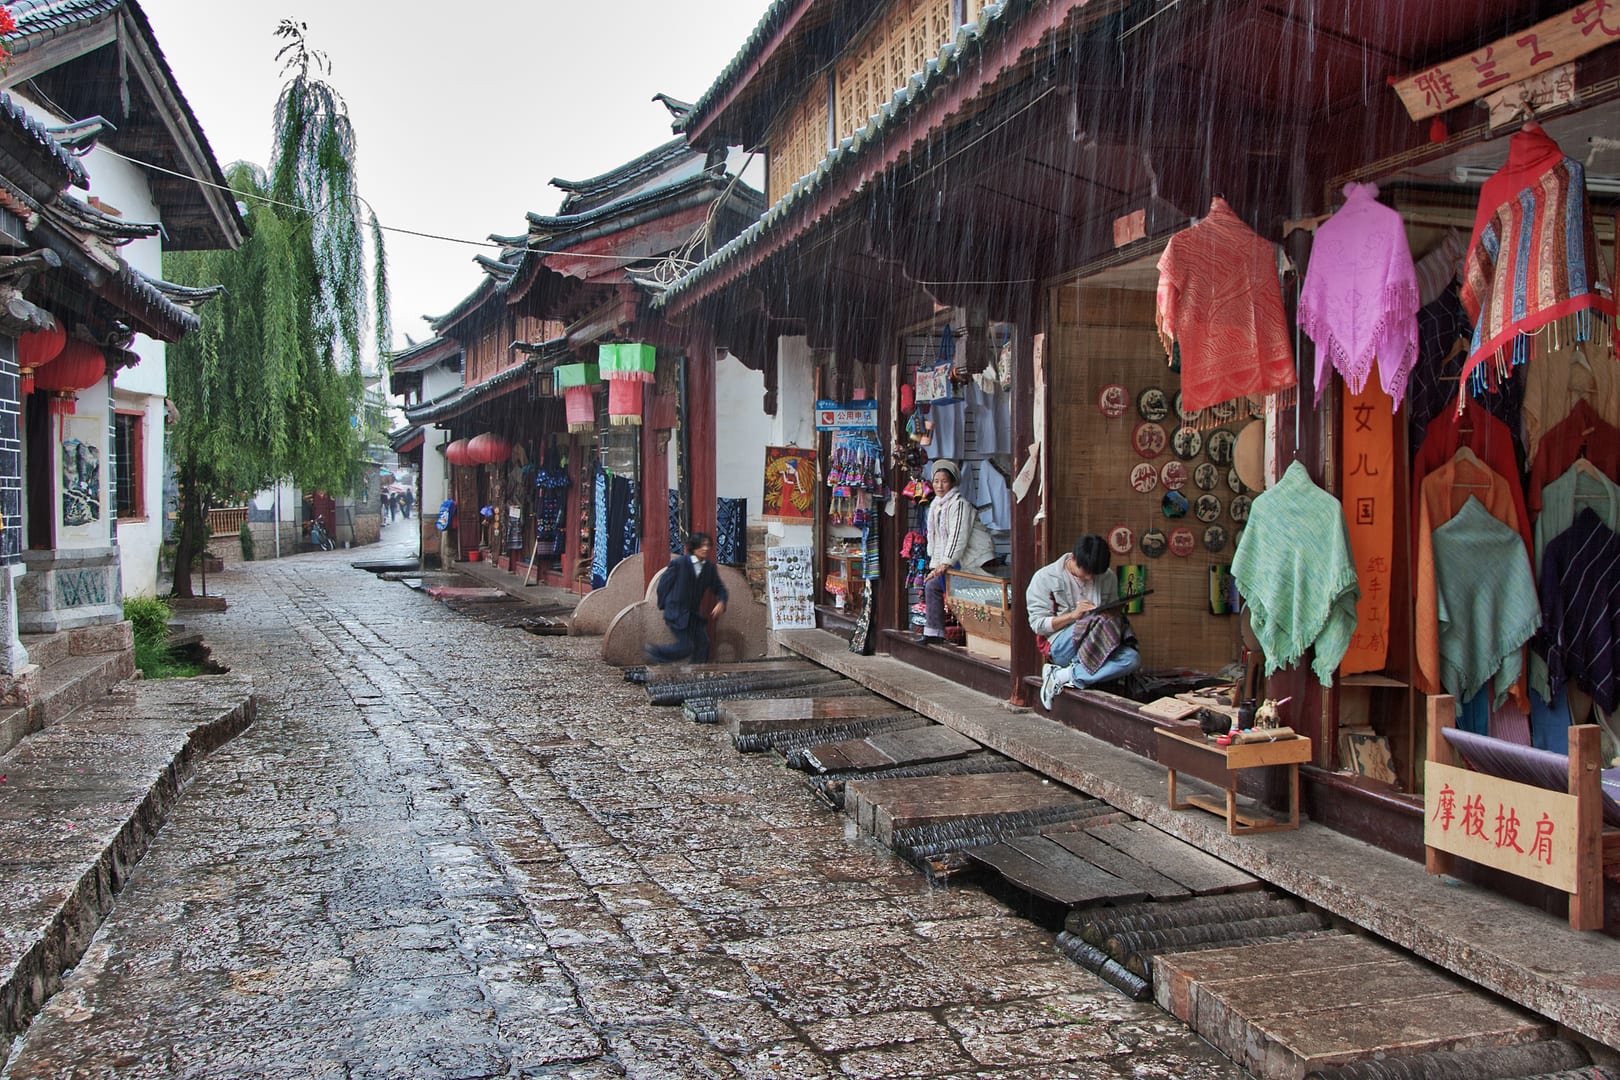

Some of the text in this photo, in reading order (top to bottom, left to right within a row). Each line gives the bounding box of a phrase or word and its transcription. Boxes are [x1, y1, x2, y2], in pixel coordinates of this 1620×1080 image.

[1350, 402, 1378, 526] 女儿国
[1432, 783, 1555, 865] 摩梭披肩
